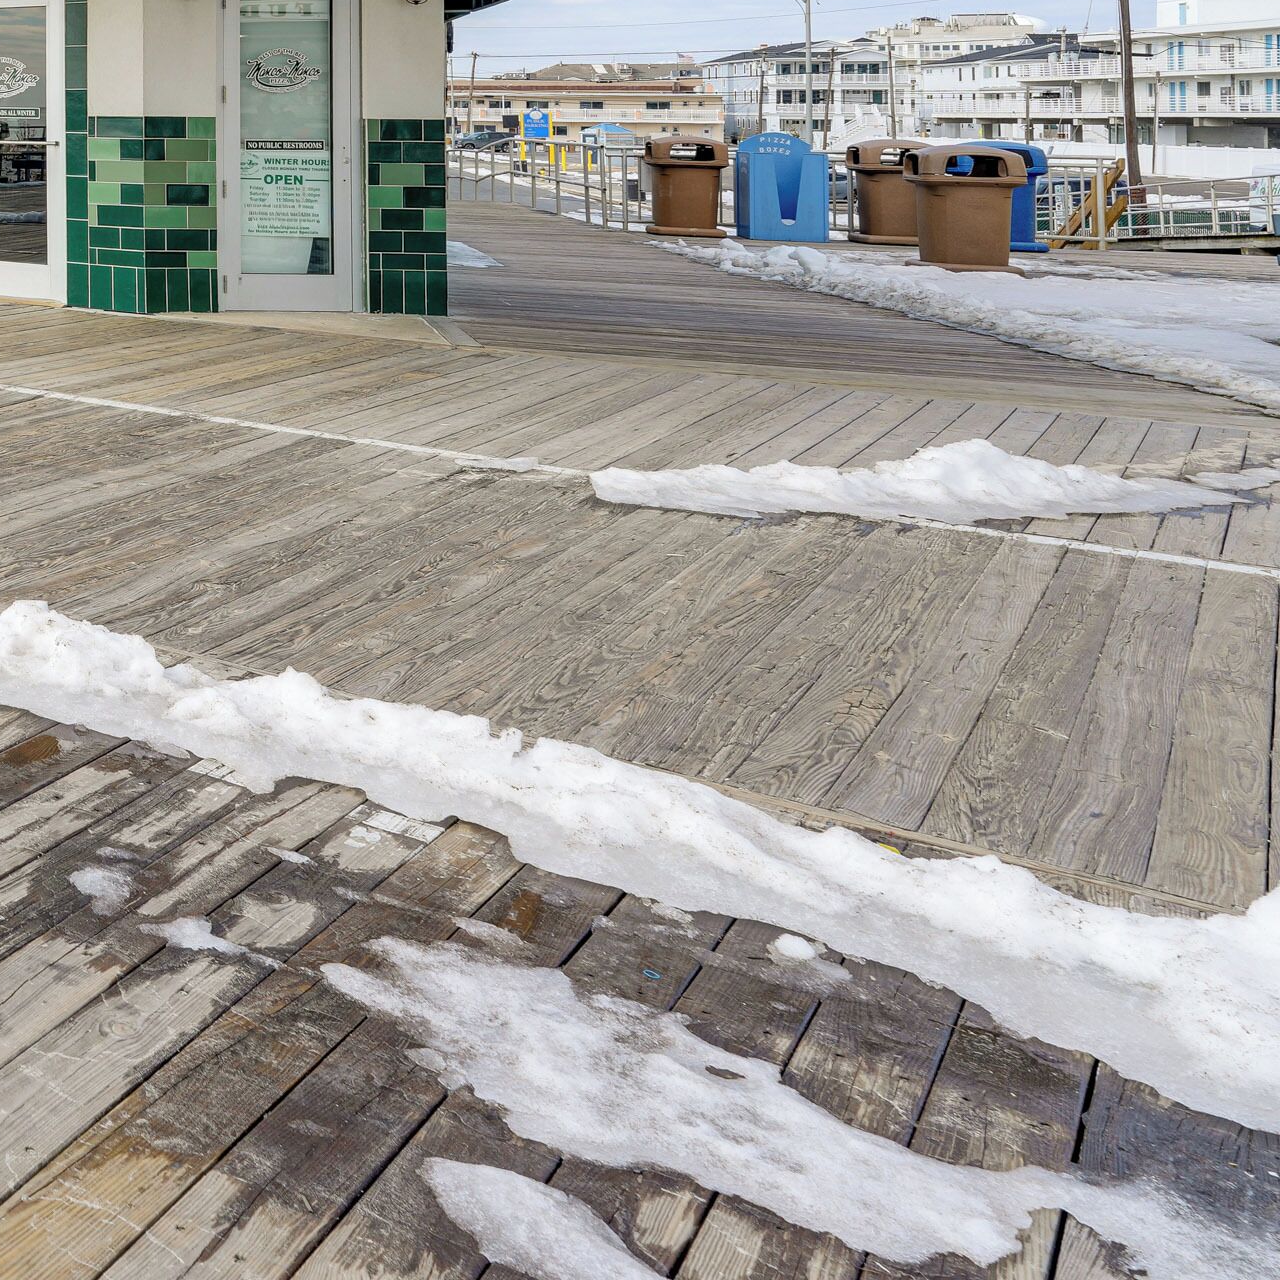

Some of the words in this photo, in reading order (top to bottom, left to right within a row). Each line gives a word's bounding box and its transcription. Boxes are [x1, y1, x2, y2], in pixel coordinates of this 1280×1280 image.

[258, 141, 281, 149] PUBLIC
[282, 141, 323, 149] RESTROOMS
[759, 136, 791, 146] PIZZA
[759, 146, 791, 156] BOXES
[263, 158, 299, 166] WINTER
[263, 174, 304, 185] OPEN
